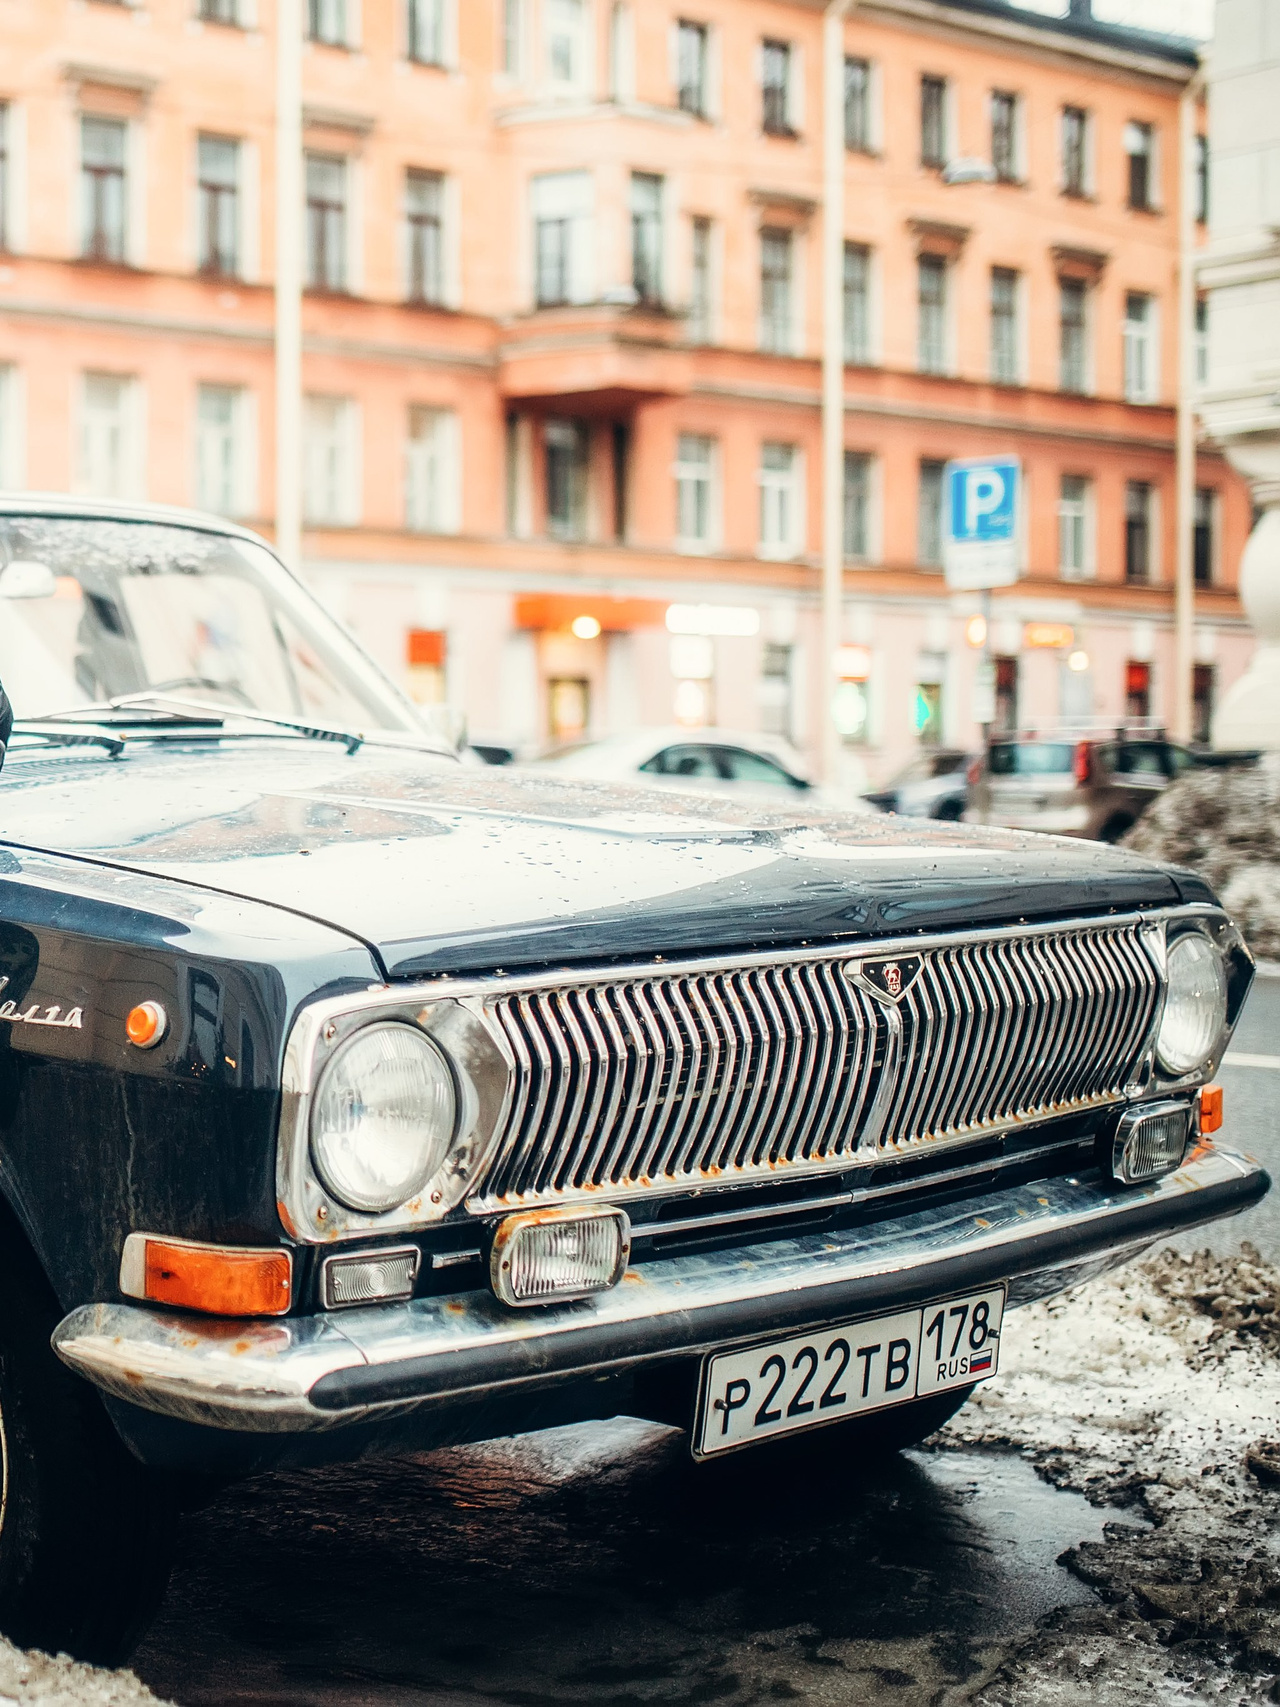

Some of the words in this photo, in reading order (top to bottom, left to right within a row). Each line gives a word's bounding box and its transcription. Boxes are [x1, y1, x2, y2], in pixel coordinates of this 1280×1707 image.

[965, 469, 1006, 533] P
[926, 1301, 990, 1362] 178
[937, 1357, 969, 1382] RUS
